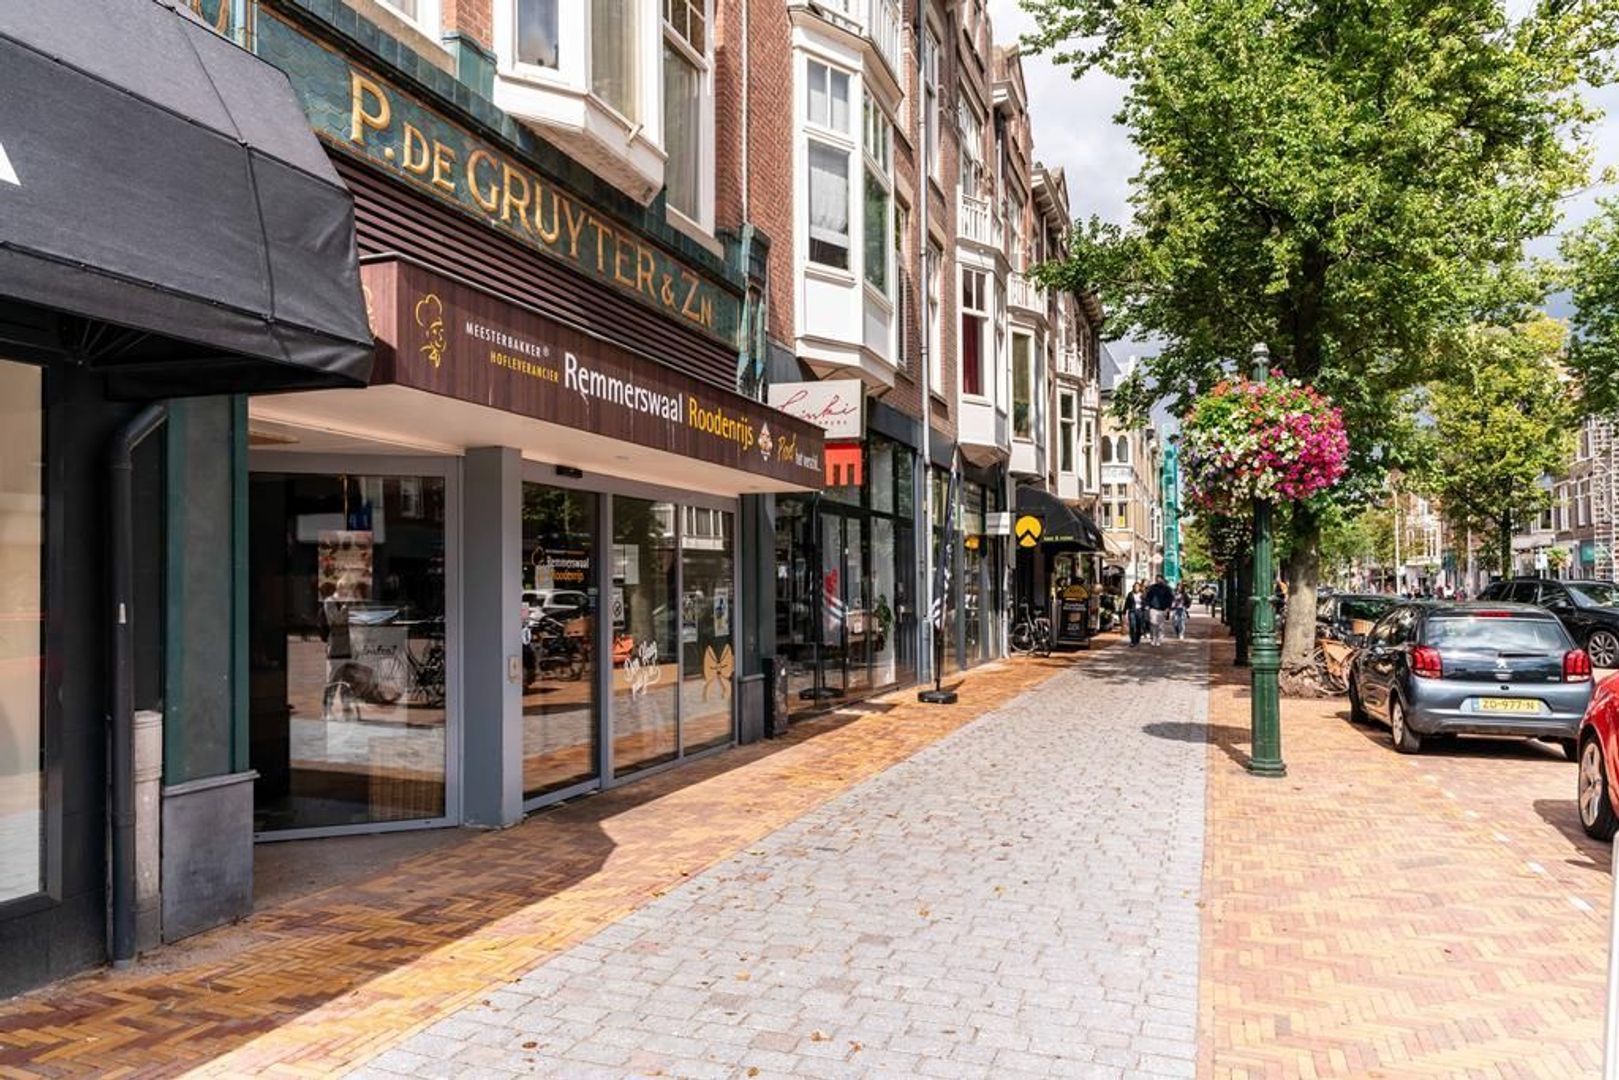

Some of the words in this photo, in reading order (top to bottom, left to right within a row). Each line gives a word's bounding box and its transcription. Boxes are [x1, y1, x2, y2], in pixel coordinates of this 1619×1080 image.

[466, 149, 657, 300] GRUYTER
[661, 273, 679, 311] &
[490, 350, 559, 383] HOFLEVERANCIER
[564, 352, 683, 423] Remmerswaal
[688, 396, 755, 451] Roodenrijs
